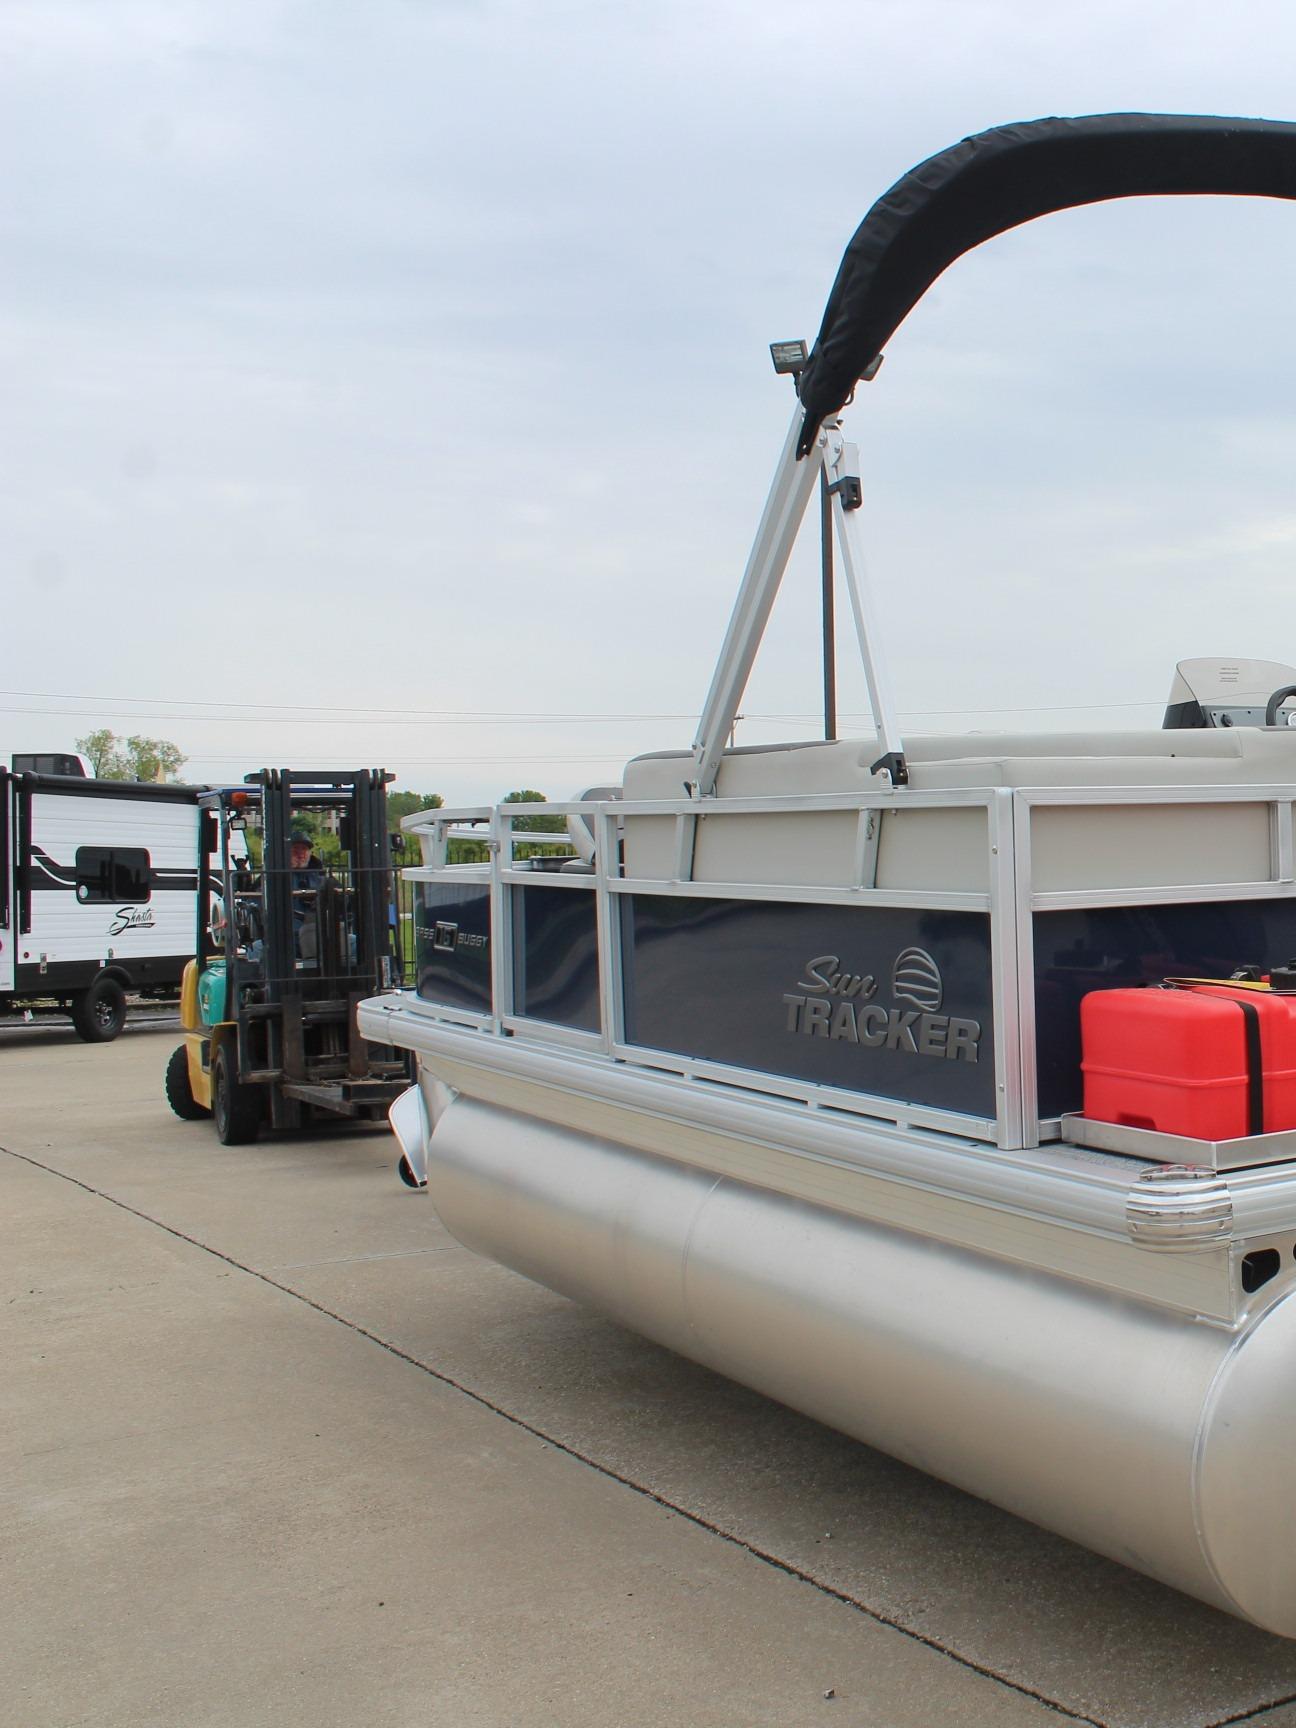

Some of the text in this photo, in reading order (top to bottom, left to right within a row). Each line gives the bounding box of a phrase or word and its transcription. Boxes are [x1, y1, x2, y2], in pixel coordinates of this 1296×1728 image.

[458, 933, 488, 948] BUGGY
[797, 956, 878, 999] Sun
[783, 994, 981, 1063] TRACKER
